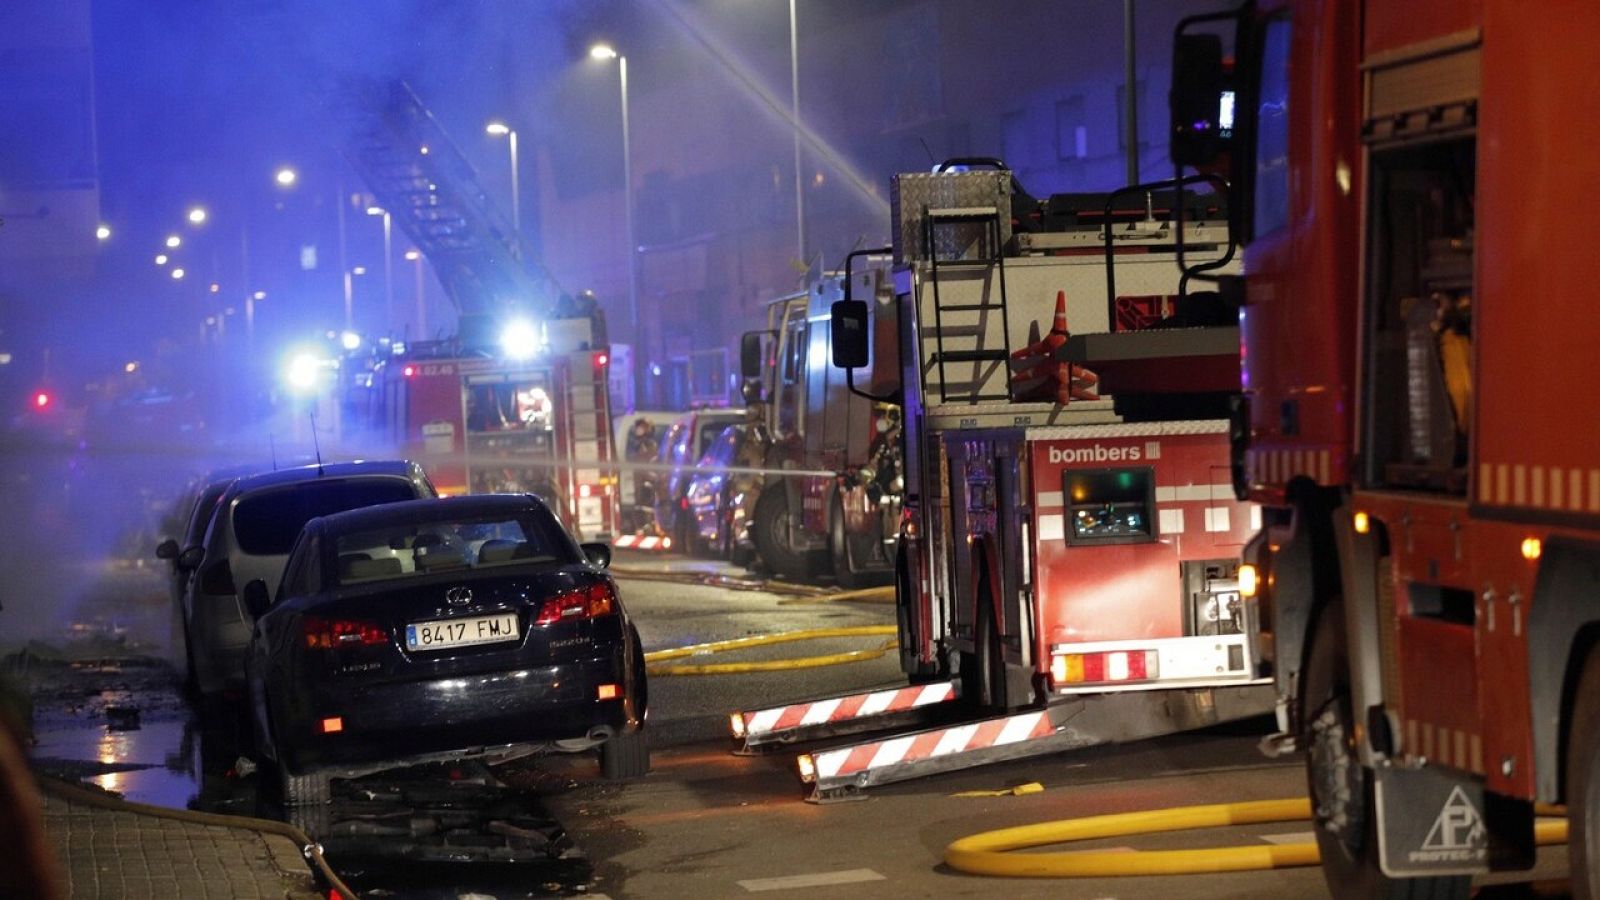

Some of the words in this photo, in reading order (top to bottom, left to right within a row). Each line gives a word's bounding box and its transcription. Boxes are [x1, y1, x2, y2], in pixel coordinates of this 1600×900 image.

[1049, 444, 1141, 464] bombers
[421, 623, 466, 645] 8417
[477, 618, 512, 638] FMJ
